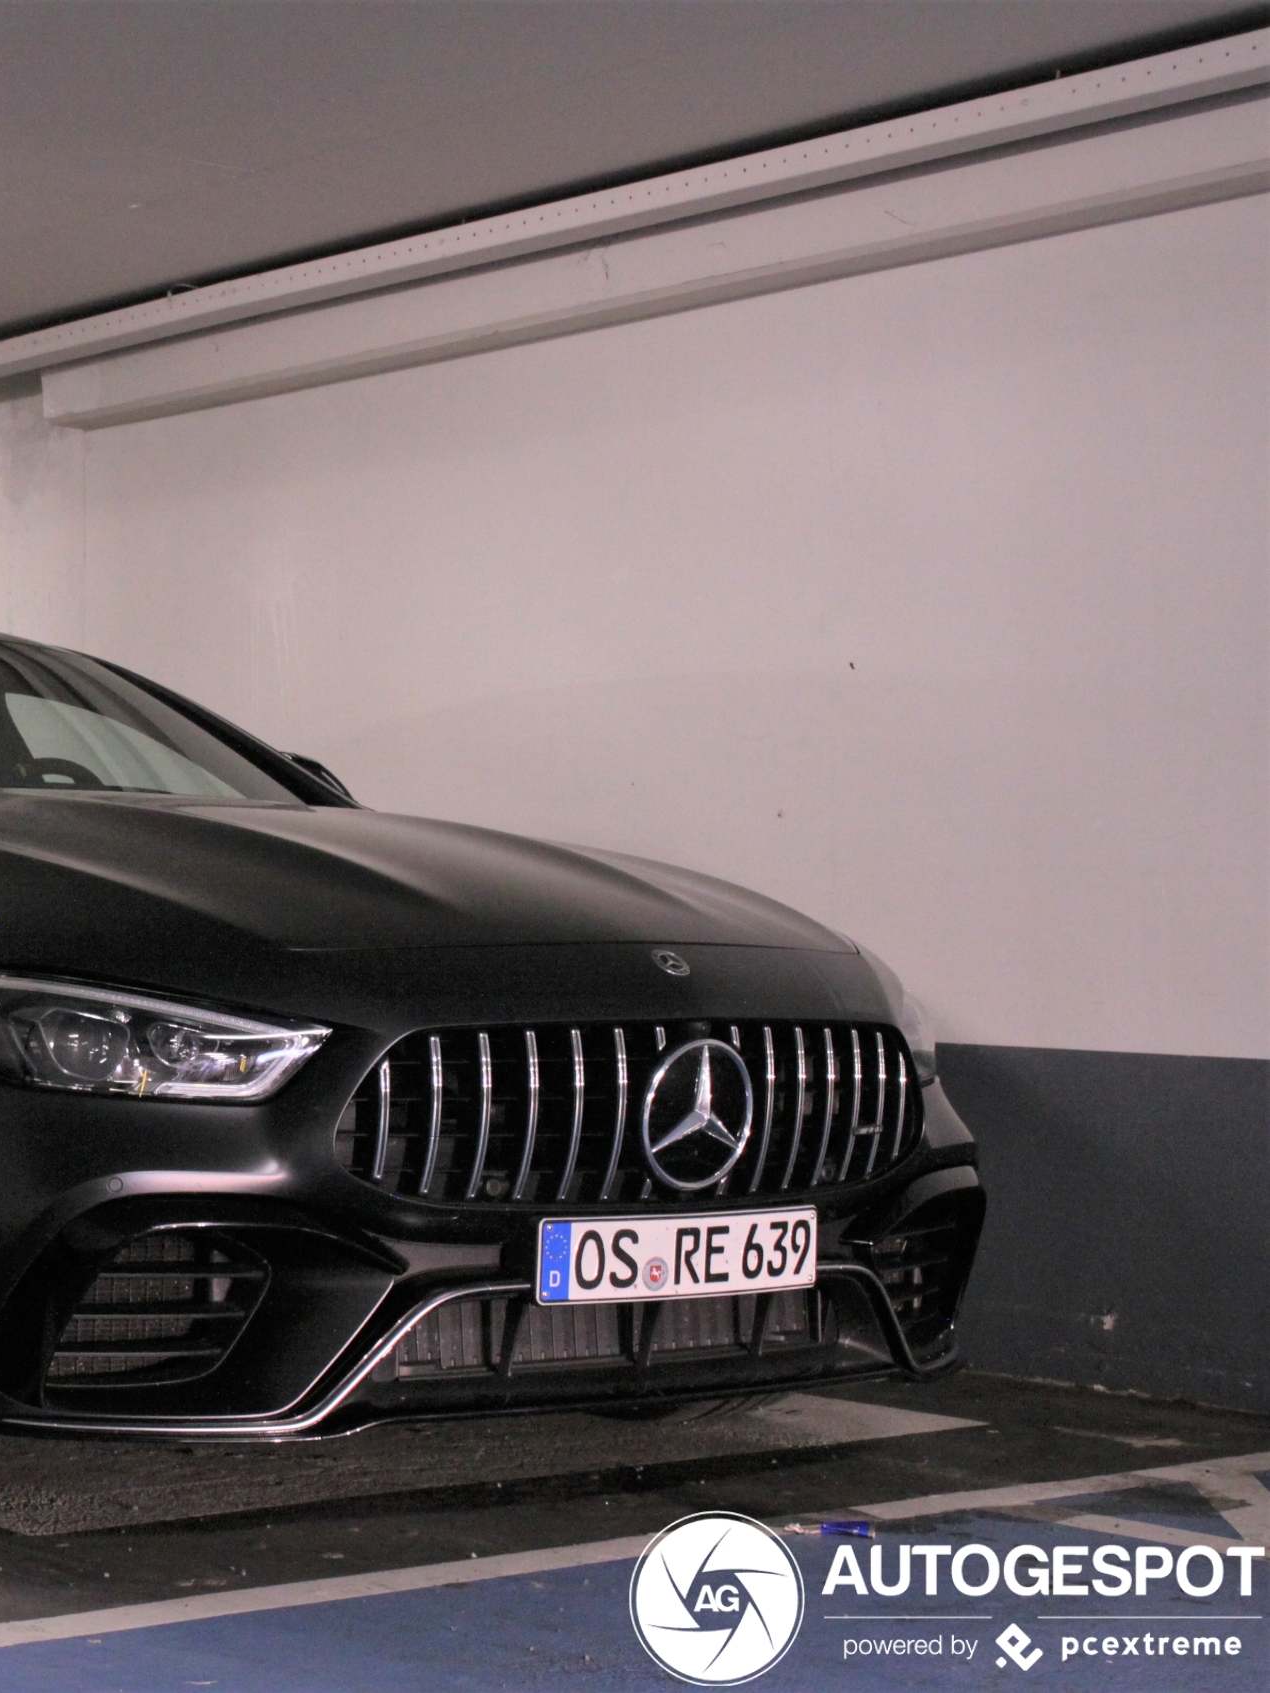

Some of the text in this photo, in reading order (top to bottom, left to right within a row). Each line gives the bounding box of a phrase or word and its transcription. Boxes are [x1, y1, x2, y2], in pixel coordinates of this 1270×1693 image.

[574, 1219, 811, 1290] OS RE 639
[549, 1270, 561, 1288] D
